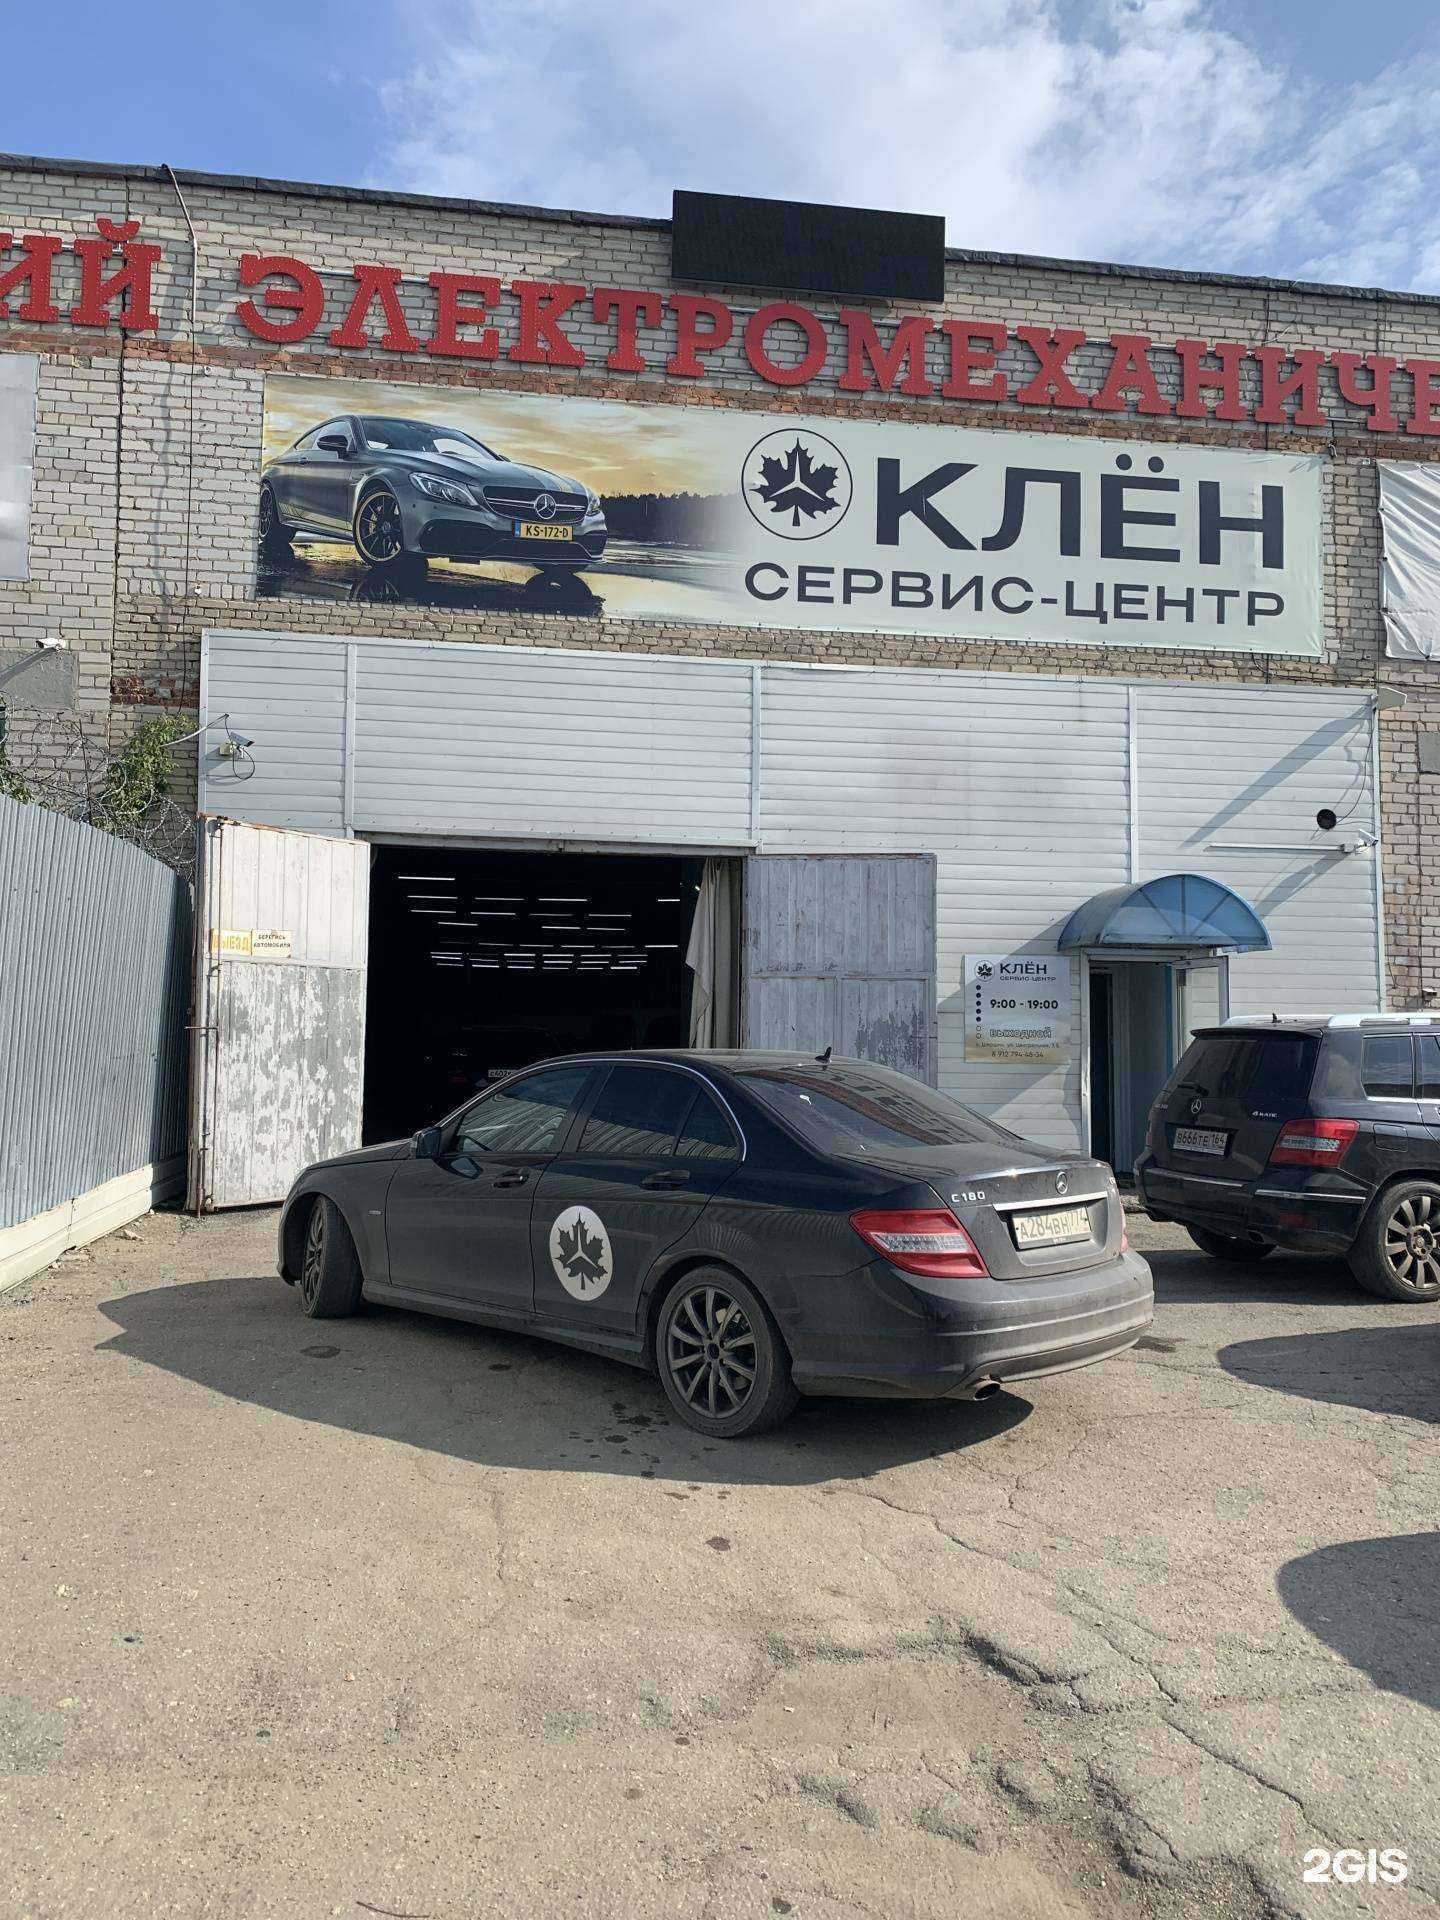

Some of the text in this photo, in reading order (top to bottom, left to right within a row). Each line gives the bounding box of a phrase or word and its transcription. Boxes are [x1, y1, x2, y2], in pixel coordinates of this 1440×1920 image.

[876, 454, 1284, 569] КЛЁН
[526, 524, 568, 538] KS-172-D
[745, 562, 1285, 626] СЕРВИС-ЦЕНТР
[1000, 961, 1047, 974] КЛЁН
[990, 999, 1016, 1008] 9:00
[1028, 999, 1059, 1009] 19:00
